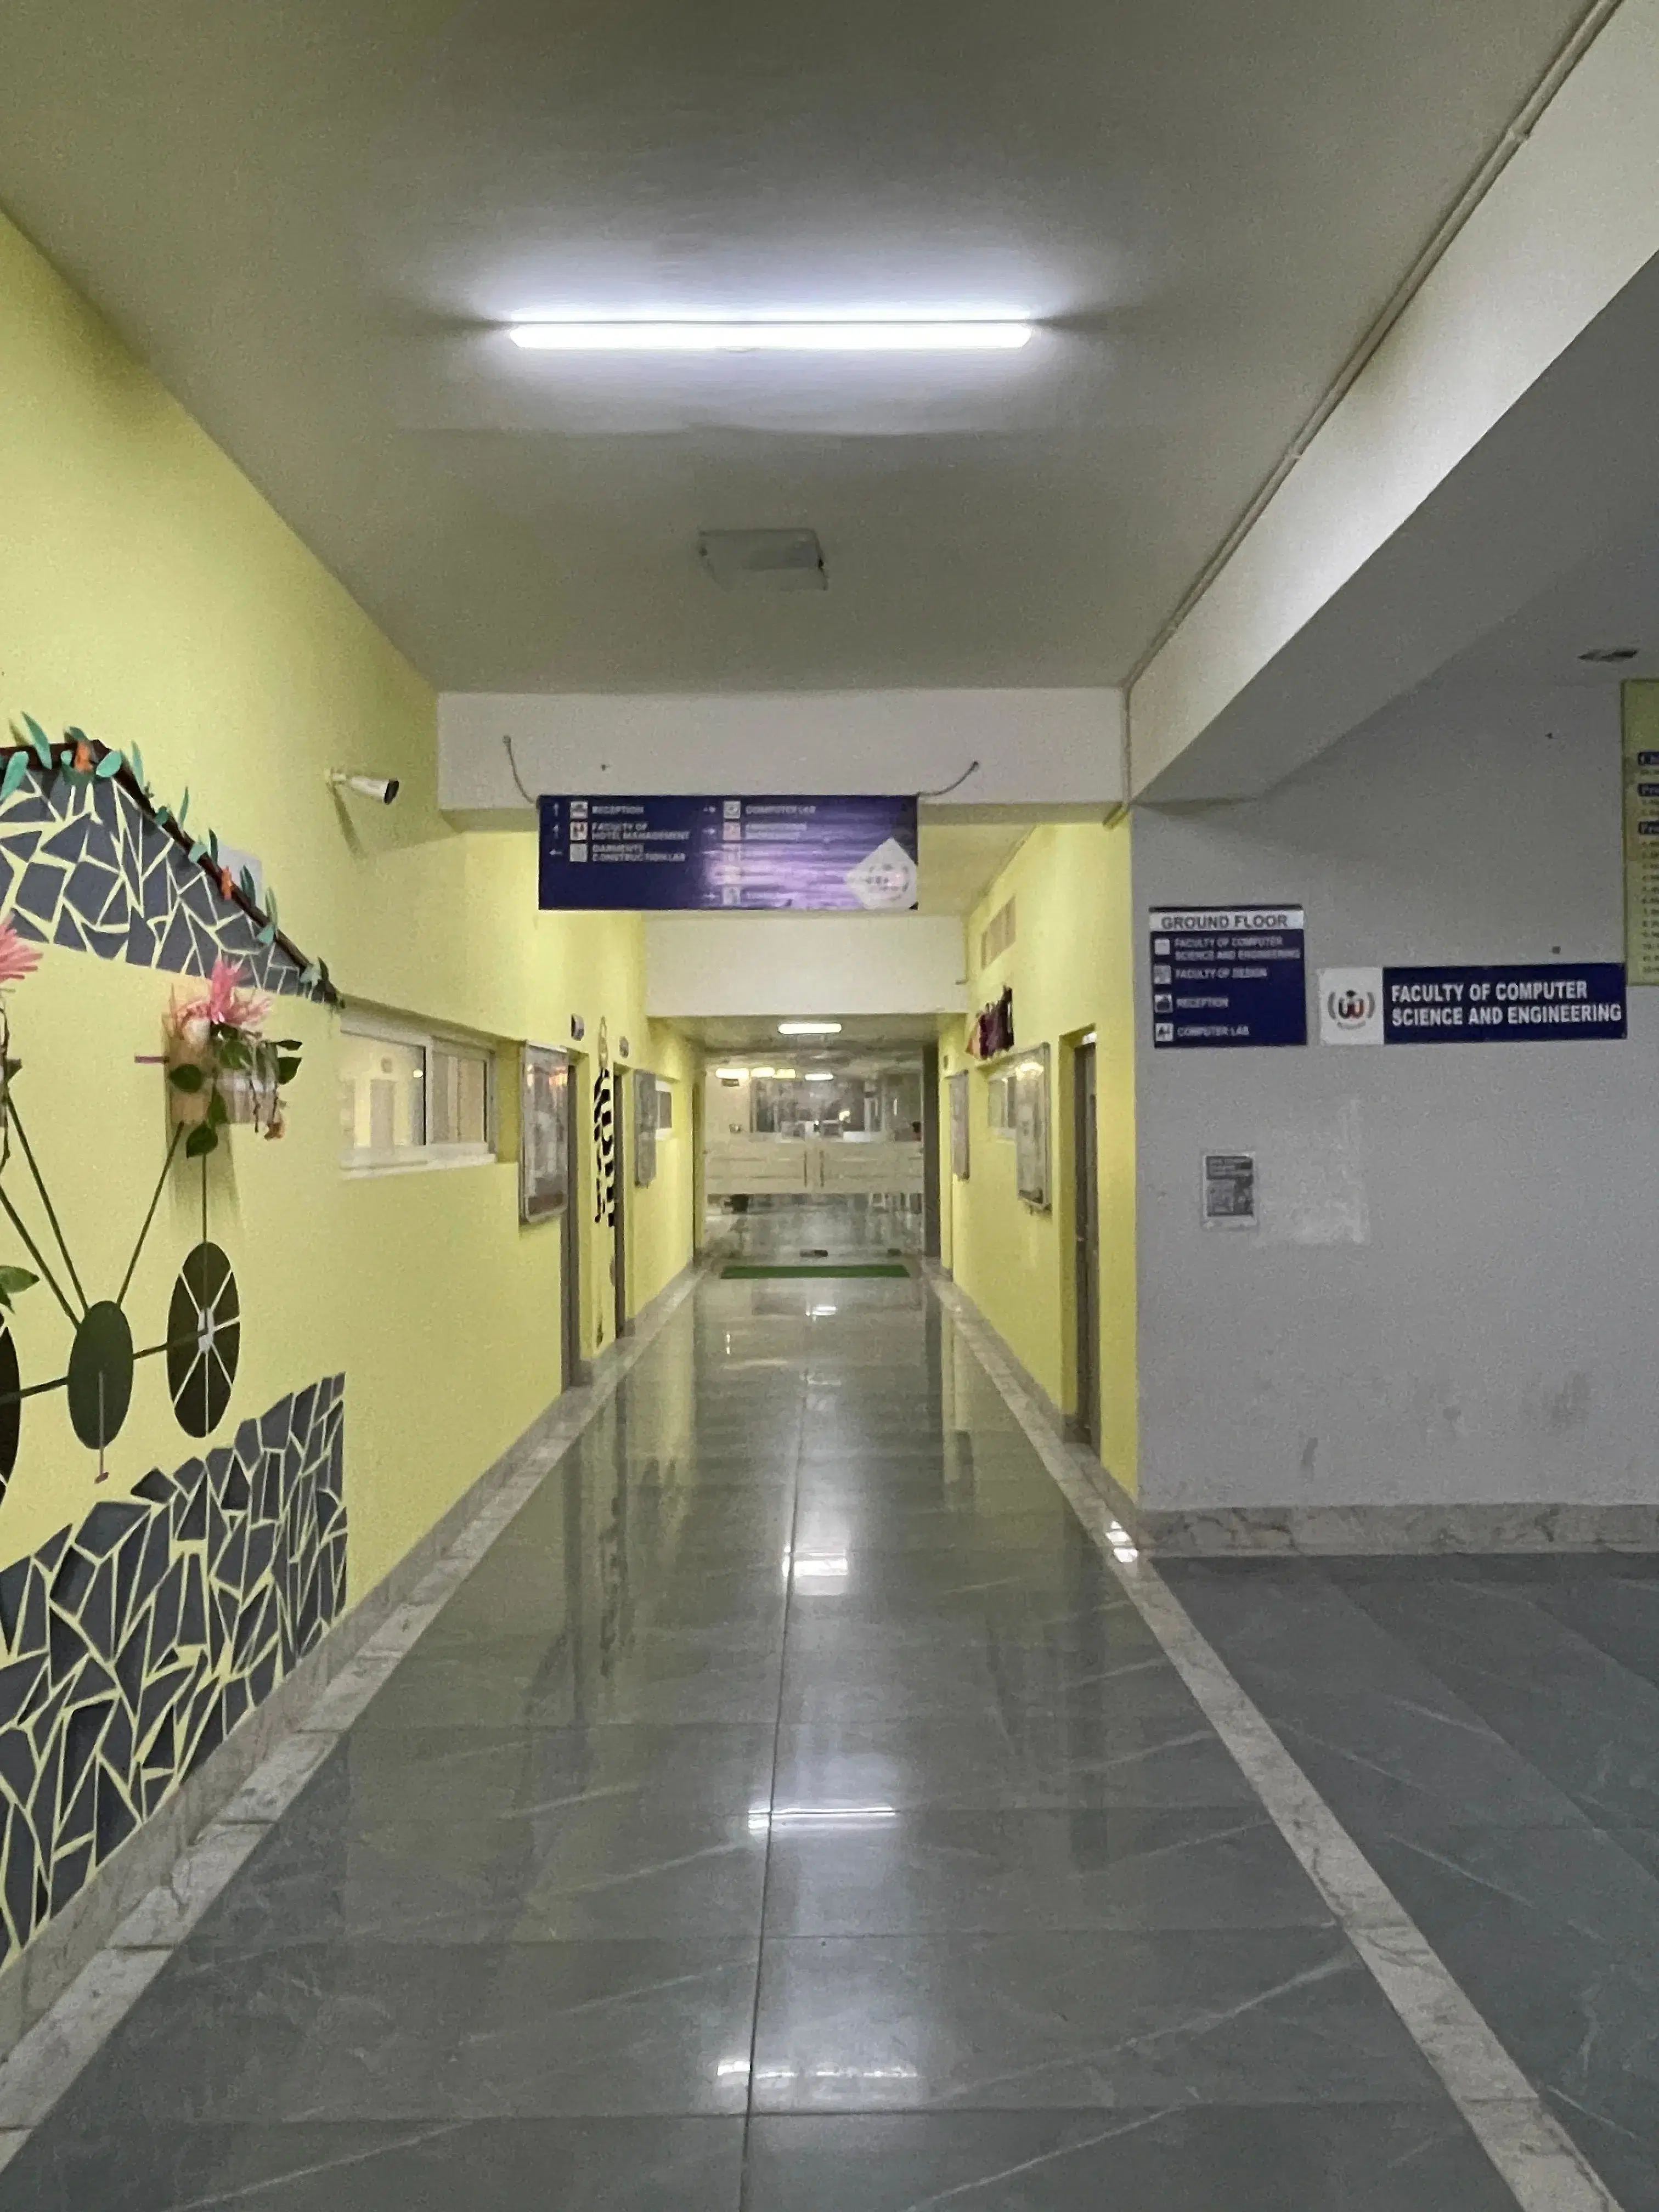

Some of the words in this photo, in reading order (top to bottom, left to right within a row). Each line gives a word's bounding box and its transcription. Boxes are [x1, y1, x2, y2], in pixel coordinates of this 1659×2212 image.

[1161, 916, 1229, 929] GROUND
[1234, 915, 1288, 928] FLOOR
[1175, 938, 1215, 948] FACULTY
[1217, 937, 1229, 947] OF
[1232, 936, 1283, 947] COMPUTER
[1175, 968, 1216, 979] FACULTY
[1217, 967, 1230, 979] OF
[1391, 984, 1464, 1003] FACULTY
[1469, 983, 1491, 1002] OF
[1496, 981, 1587, 1001] COMPUTER
[1392, 1007, 1463, 1027] SCIENCE
[1468, 1006, 1503, 1025] AND
[1508, 1003, 1622, 1024] ENGINEERING
[1177, 1025, 1229, 1037] COMPUTER
[1231, 1024, 1250, 1036] LAB
